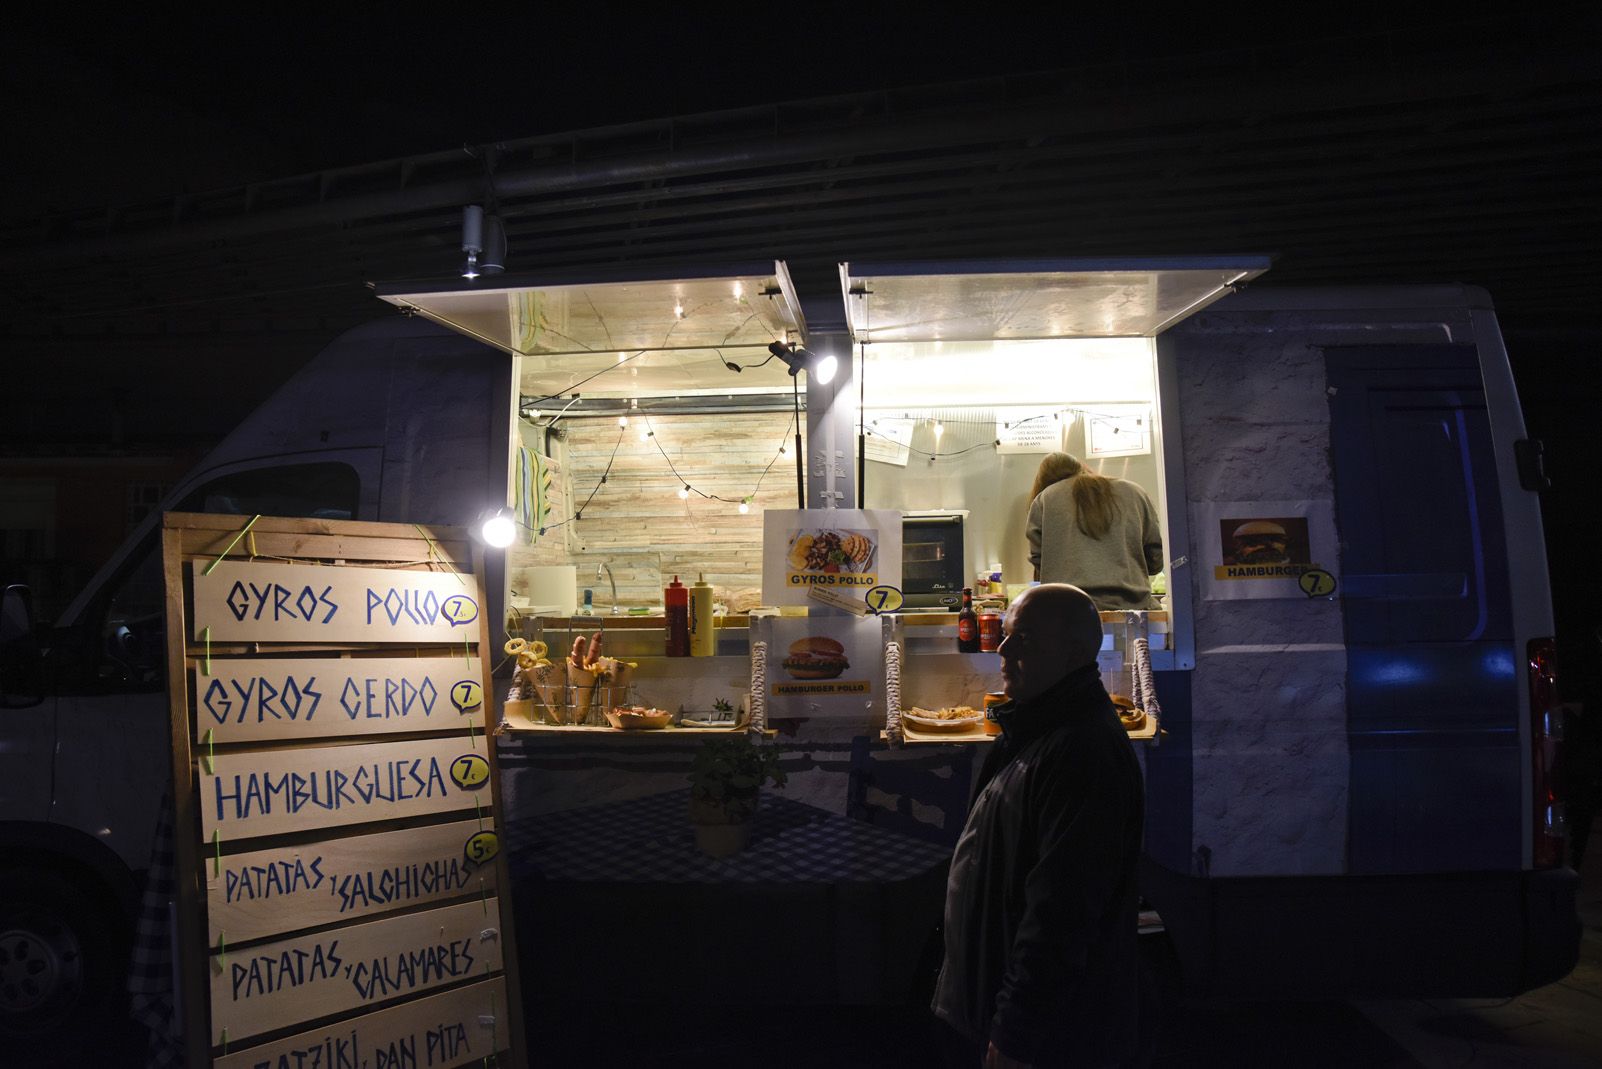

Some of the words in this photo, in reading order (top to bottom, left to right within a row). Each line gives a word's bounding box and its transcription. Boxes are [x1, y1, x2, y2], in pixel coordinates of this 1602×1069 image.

[226, 580, 339, 625] GYROS
[366, 588, 440, 626] POLLO
[791, 574, 836, 585] GYROS
[839, 576, 875, 585] POLLO
[203, 676, 323, 725] GYROS
[339, 675, 438, 721] CERDO
[777, 684, 835, 694] HAMBURGER
[837, 684, 865, 692] POLLO
[214, 756, 448, 821] HAMBURGUESA
[225, 856, 325, 905] PATATAS
[337, 857, 473, 913] SALCHICHAS
[231, 939, 342, 1001] PATATAS
[352, 938, 475, 1000] CALAMARES
[426, 1023, 471, 1067] PITA
